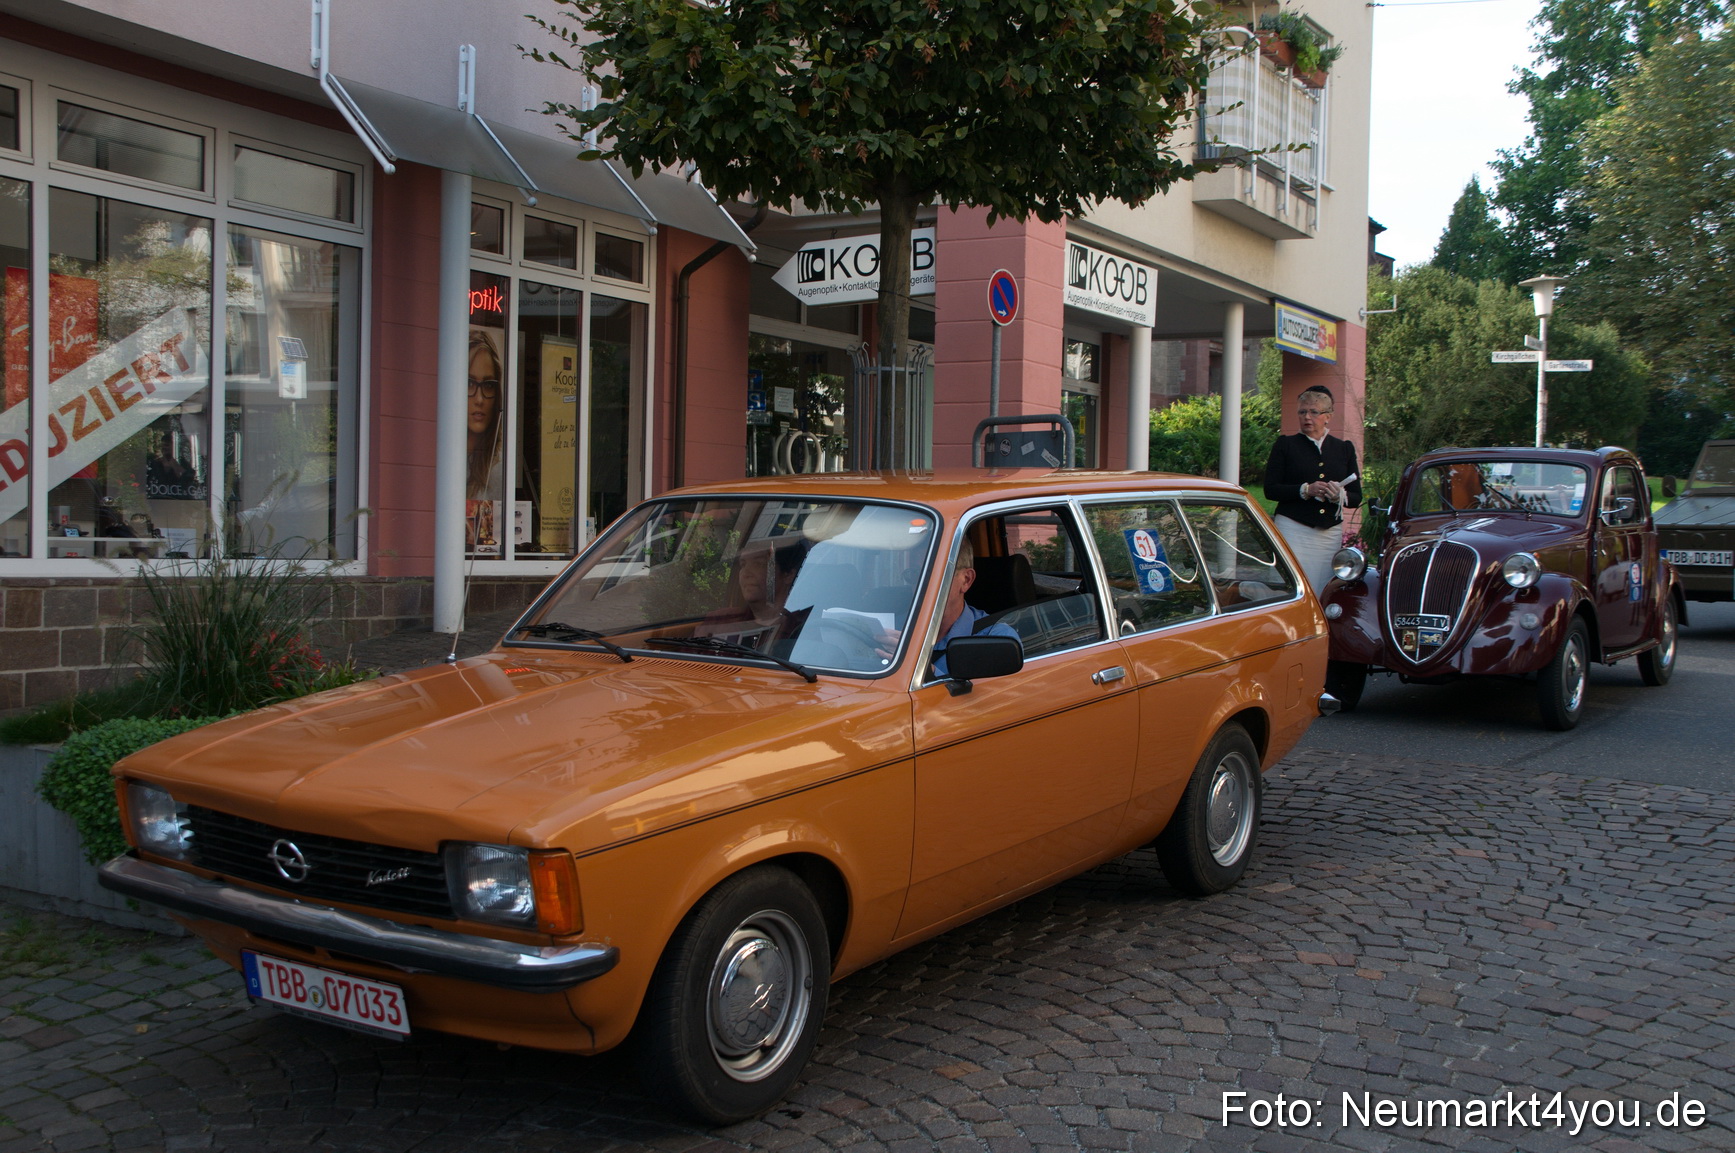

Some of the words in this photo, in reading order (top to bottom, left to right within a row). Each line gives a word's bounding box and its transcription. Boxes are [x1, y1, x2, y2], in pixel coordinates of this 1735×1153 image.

[830, 237, 935, 281] KOB
[1089, 251, 1147, 305] KOOB
[468, 285, 503, 315] ptik
[798, 285, 838, 297] Augenoptik
[1068, 291, 1093, 308] Augenoptik
[0, 332, 190, 492] DUZIERT
[150, 484, 182, 496] DOLCE
[1135, 535, 1156, 558] 51
[1667, 551, 1688, 564] TBB
[1396, 617, 1421, 627] 58443
[366, 866, 412, 887] Kadett
[252, 977, 258, 988] D
[262, 961, 308, 1003] TBB
[324, 976, 402, 1026] 07033
